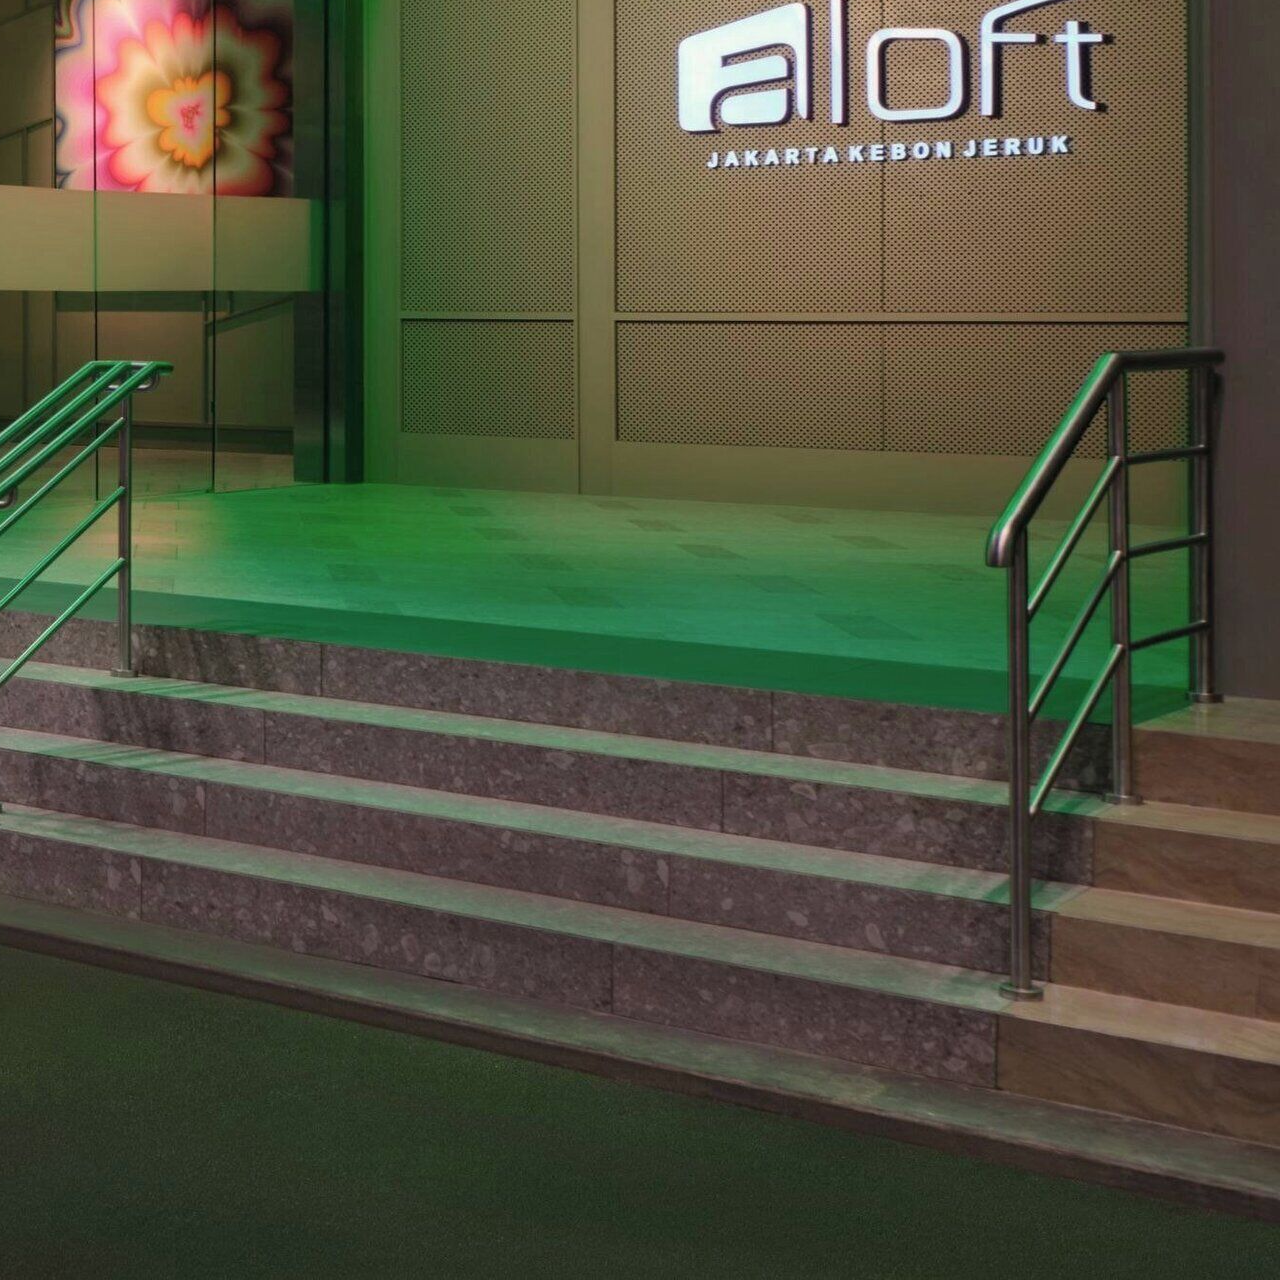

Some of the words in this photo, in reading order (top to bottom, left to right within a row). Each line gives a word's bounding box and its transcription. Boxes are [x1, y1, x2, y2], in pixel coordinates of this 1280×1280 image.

[706, 146, 839, 169] JAKARTA
[847, 140, 952, 162] KEBON
[963, 135, 1069, 158] JERUK
